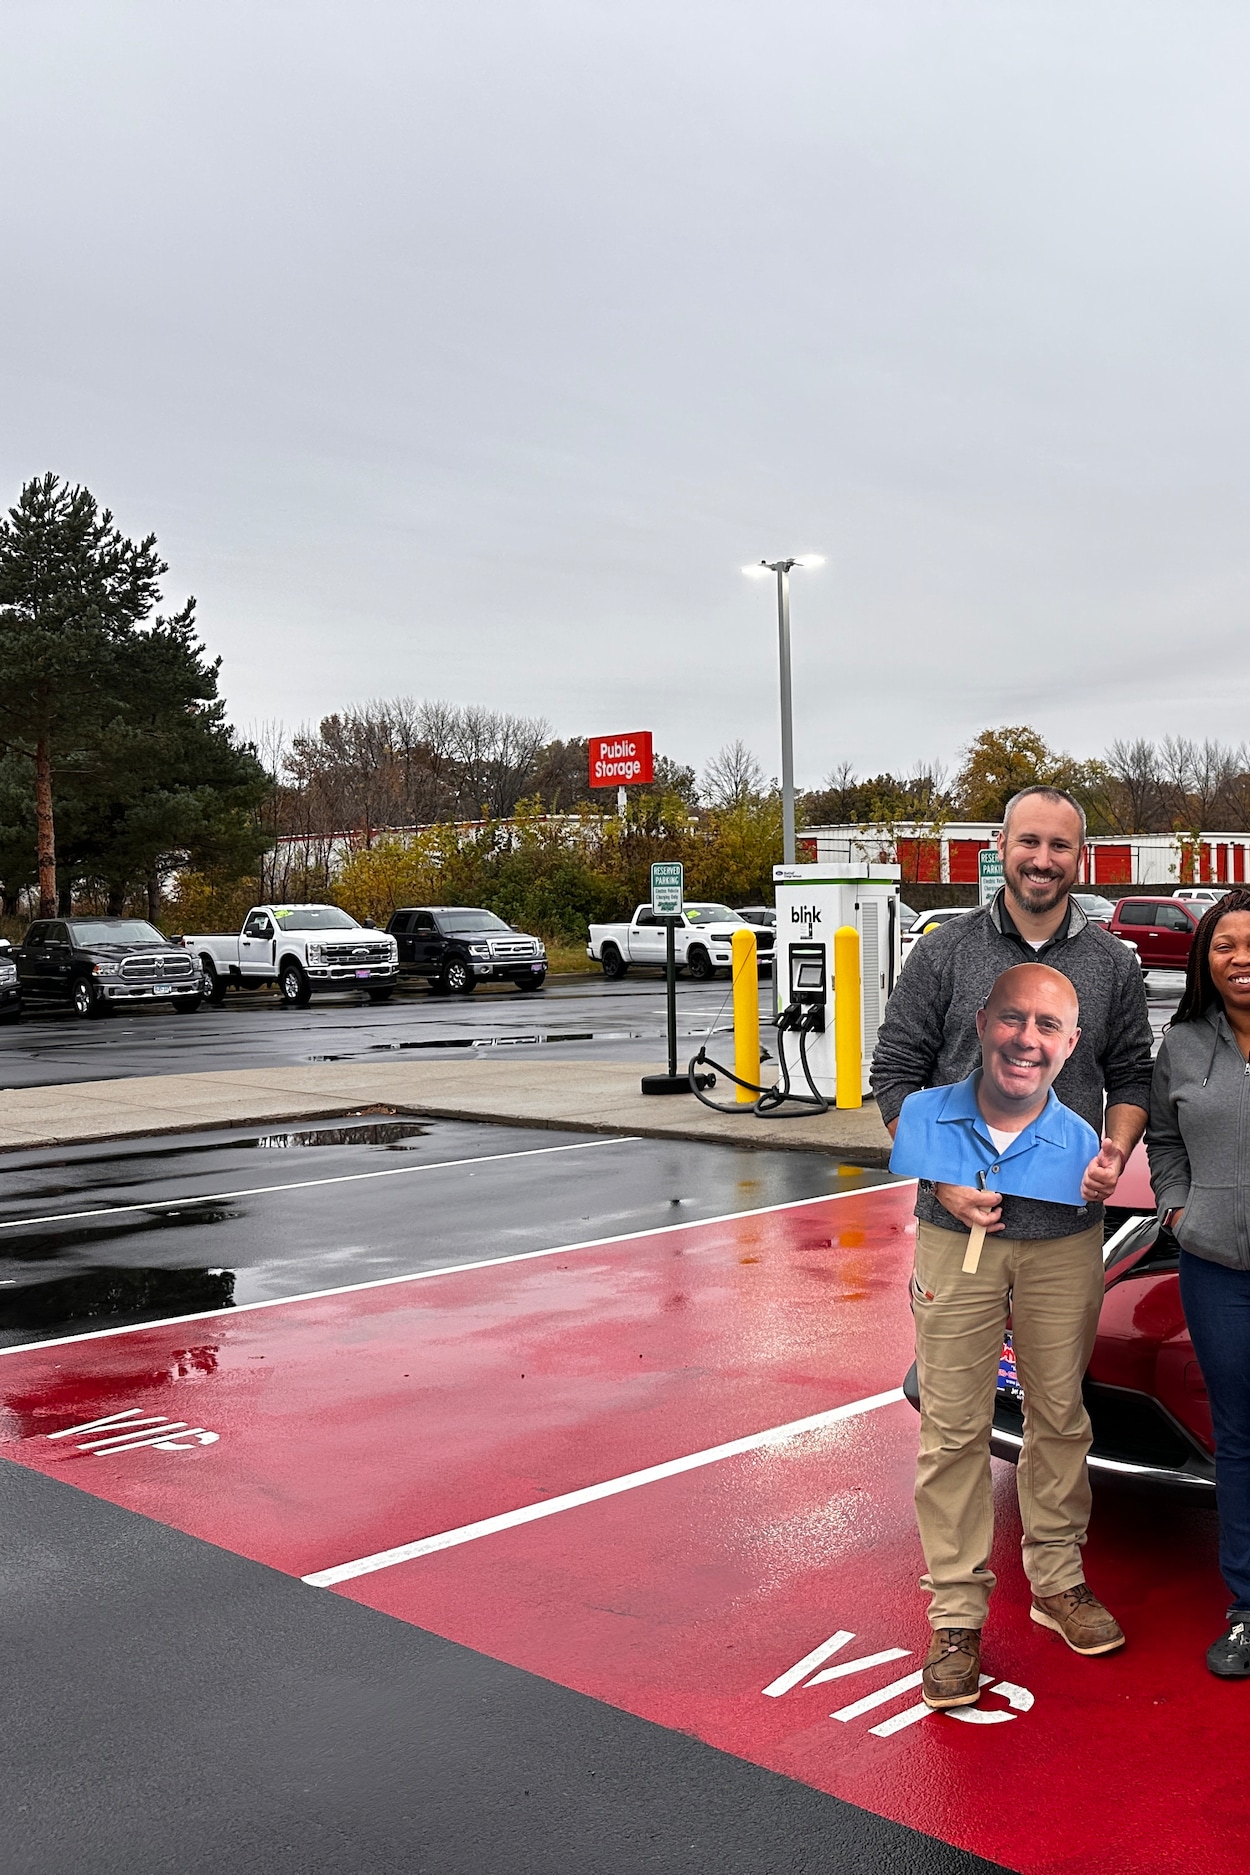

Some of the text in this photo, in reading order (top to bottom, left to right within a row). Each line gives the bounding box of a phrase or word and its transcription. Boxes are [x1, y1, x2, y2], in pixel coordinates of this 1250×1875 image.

[600, 740, 636, 759] Public
[595, 760, 641, 779] Storage
[654, 866, 680, 875] RESERVED
[655, 876, 679, 885] PARKING
[791, 905, 822, 923] blink
[46, 1407, 220, 1457] VIP
[761, 1629, 1035, 1738] VIP
